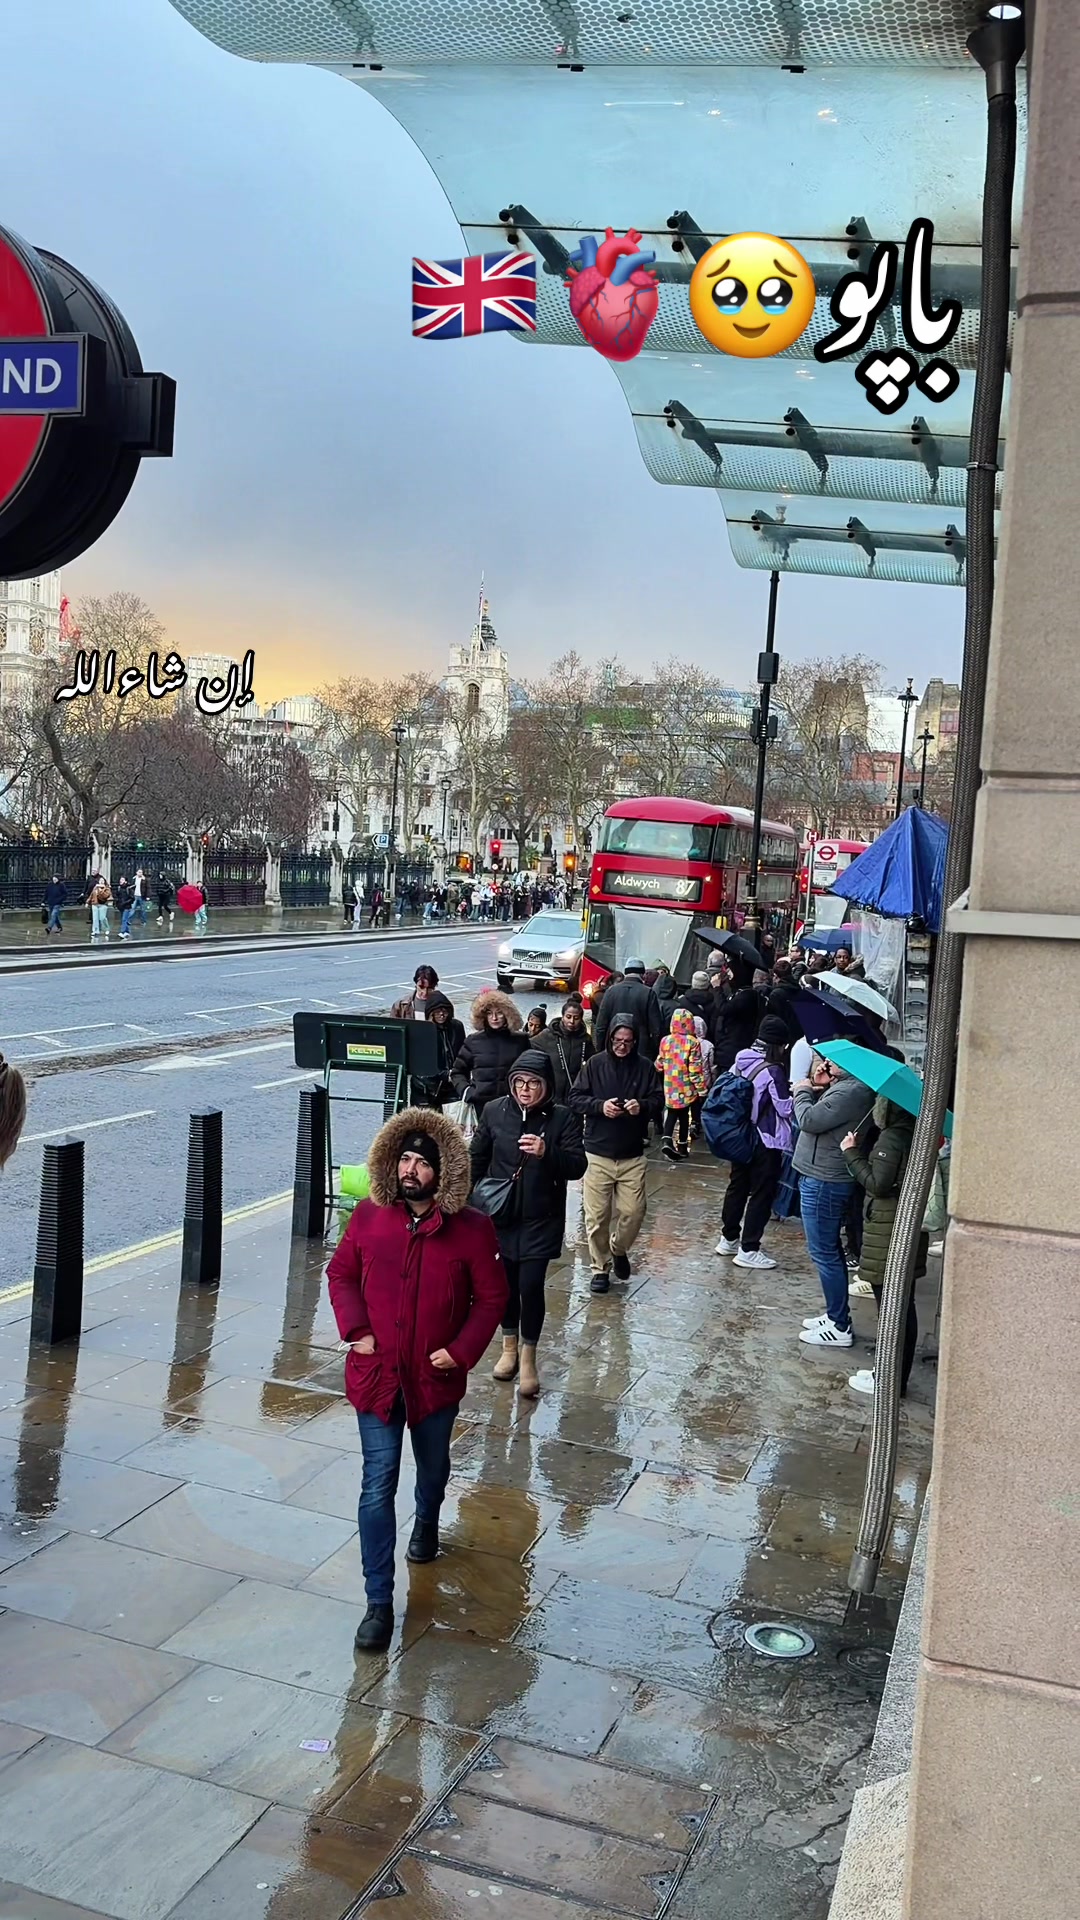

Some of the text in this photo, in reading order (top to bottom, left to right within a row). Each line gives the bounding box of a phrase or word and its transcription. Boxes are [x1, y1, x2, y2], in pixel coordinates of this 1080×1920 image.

[614, 875, 696, 896] Aldwych 87
[351, 1047, 383, 1055] KELTIC
